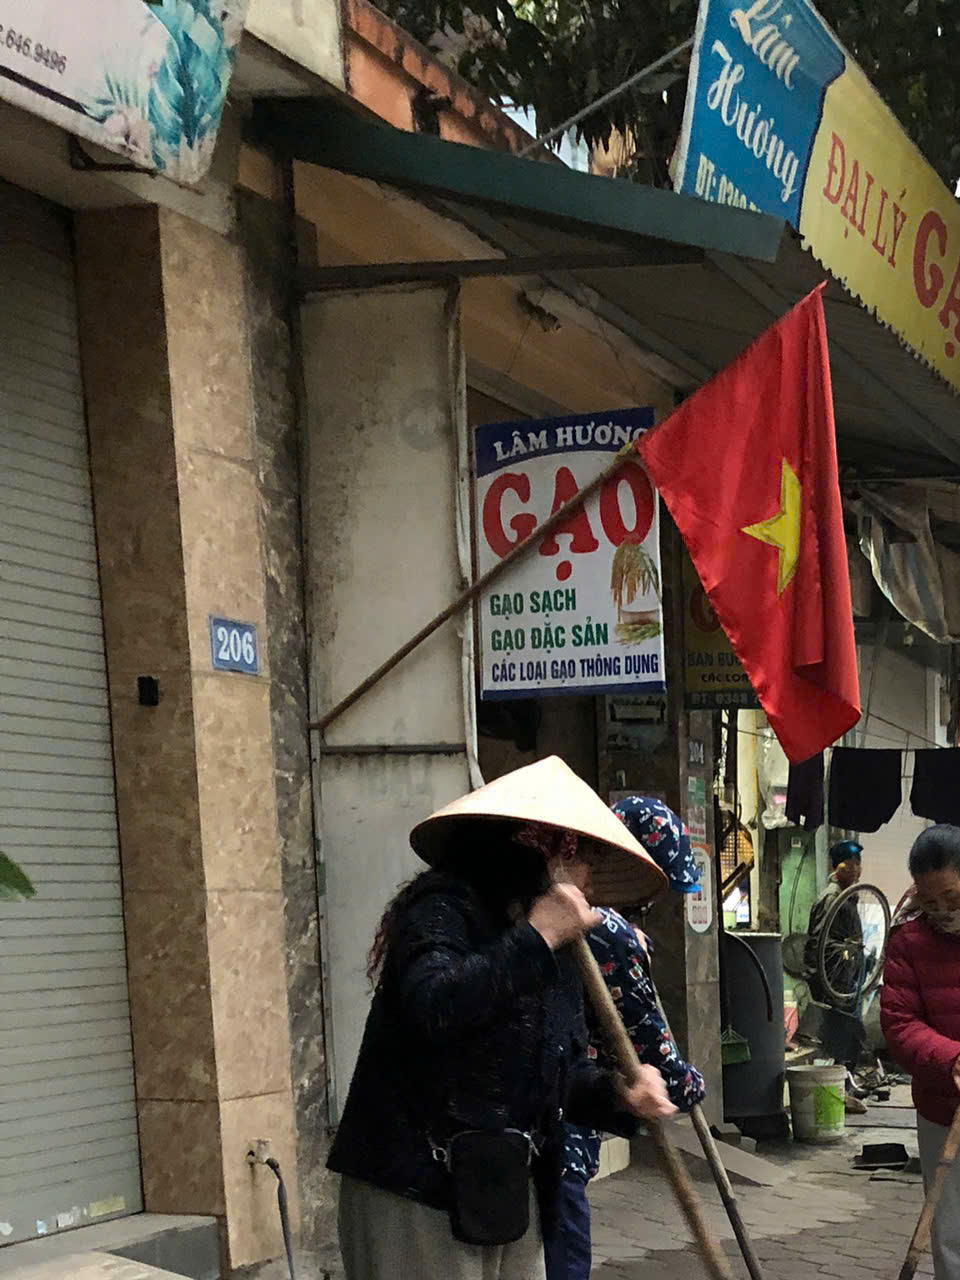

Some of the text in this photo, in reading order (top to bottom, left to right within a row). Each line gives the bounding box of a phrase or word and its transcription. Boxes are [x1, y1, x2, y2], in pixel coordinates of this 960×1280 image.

[707, 38, 800, 202] Hương
[822, 131, 908, 269] ĐẠI LÝ
[493, 430, 549, 461] LÂM
[482, 459, 656, 582] GẠO
[489, 588, 577, 620] GẠO SẠCH
[216, 626, 255, 665] 206
[491, 616, 609, 656] GẠO ĐẶC SẢN
[491, 653, 659, 685] CÁC LOẠI GẠO THÔNG DỤNG
